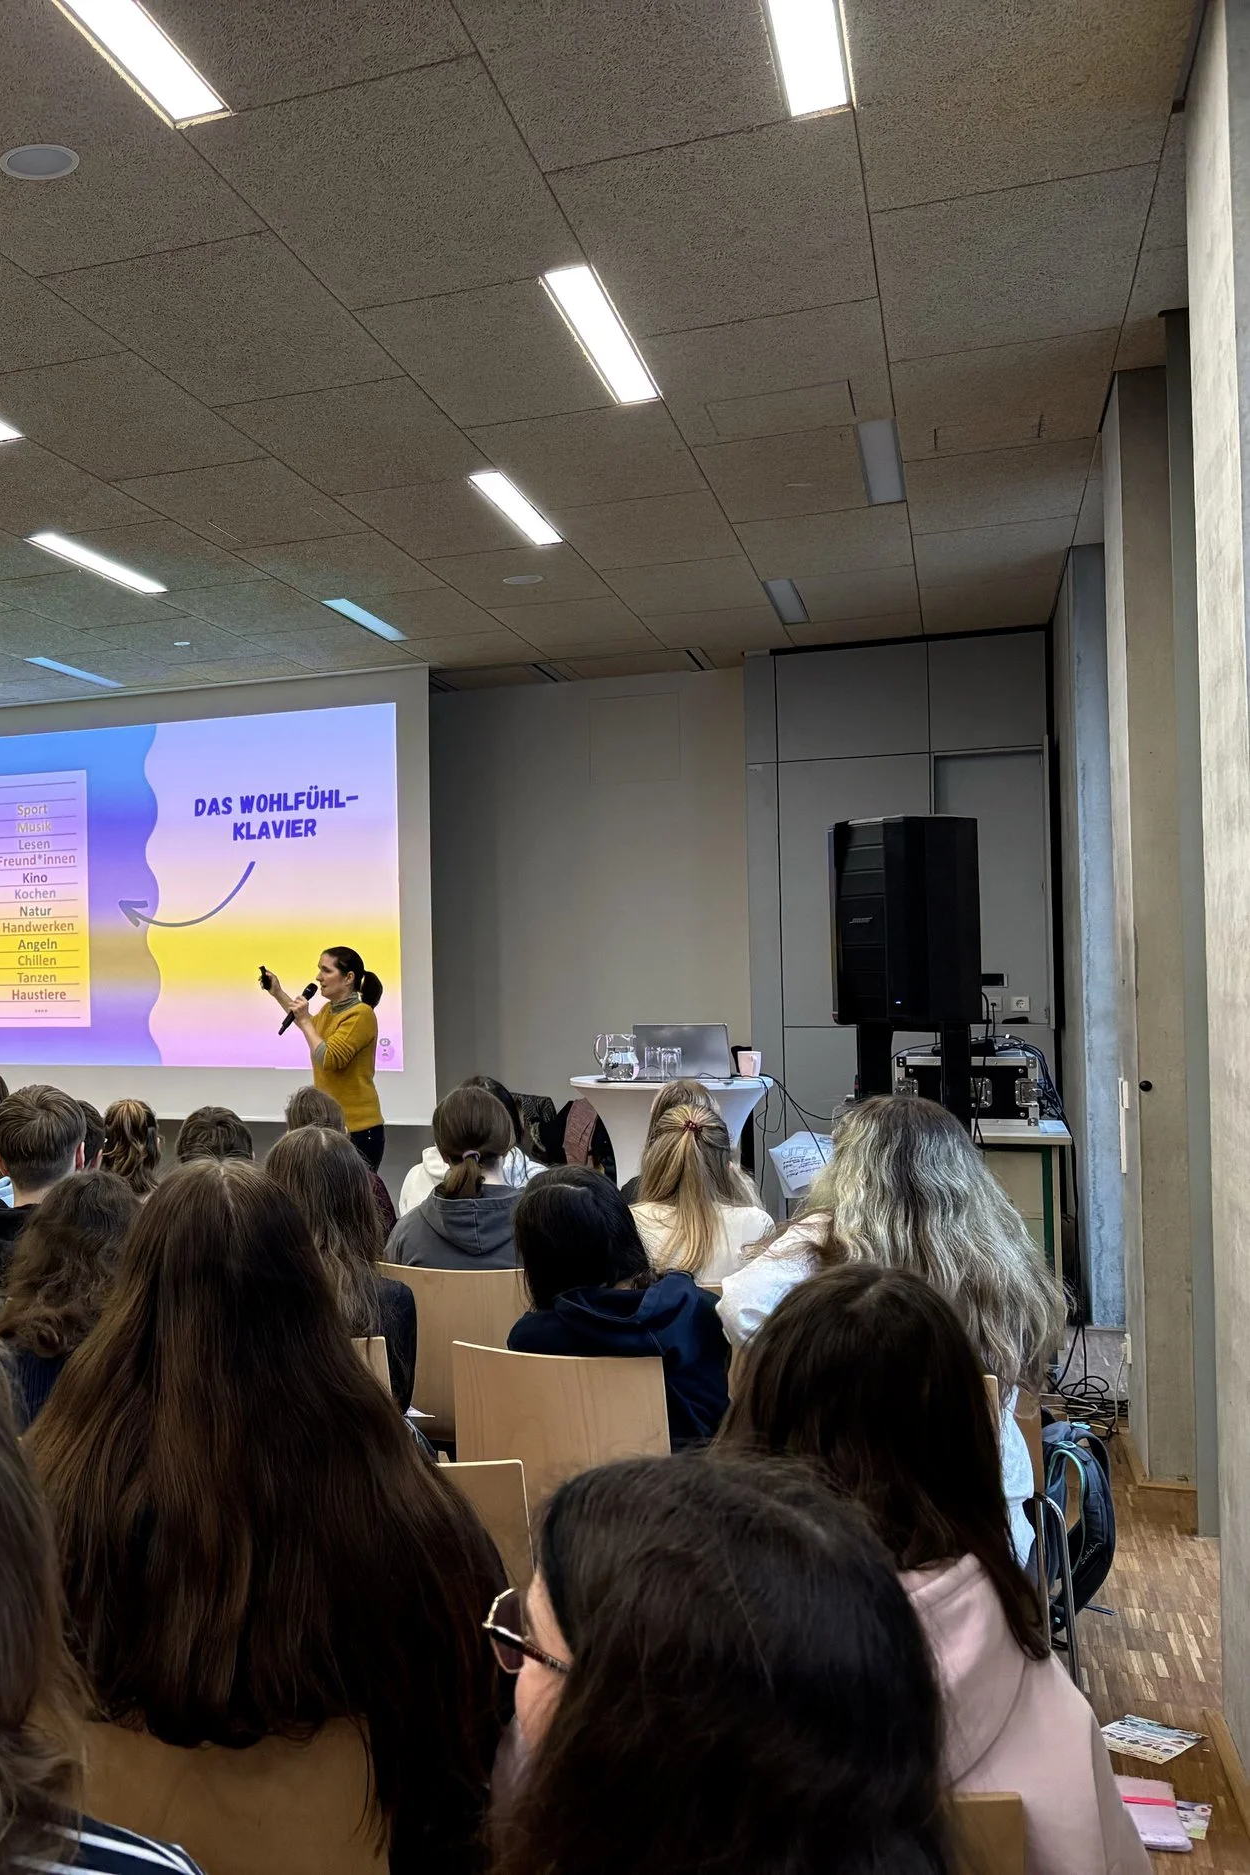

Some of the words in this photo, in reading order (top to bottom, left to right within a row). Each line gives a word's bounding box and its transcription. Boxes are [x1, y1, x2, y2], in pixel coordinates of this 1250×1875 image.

[194, 796, 233, 817] DAS
[239, 785, 359, 814] WOHLFÜHL-
[17, 804, 47, 817] Sport
[17, 821, 52, 833] Musik
[232, 818, 317, 841] KLAVIER
[18, 839, 51, 850] Lesen
[22, 872, 48, 883] Kino
[14, 887, 56, 900] Kochen
[19, 906, 52, 916] Natur
[2, 920, 75, 933] Handwerken
[17, 938, 58, 952] Angeln
[17, 954, 57, 966] Chillen
[17, 972, 57, 983] Tanzen
[11, 989, 67, 1000] Haustiere
